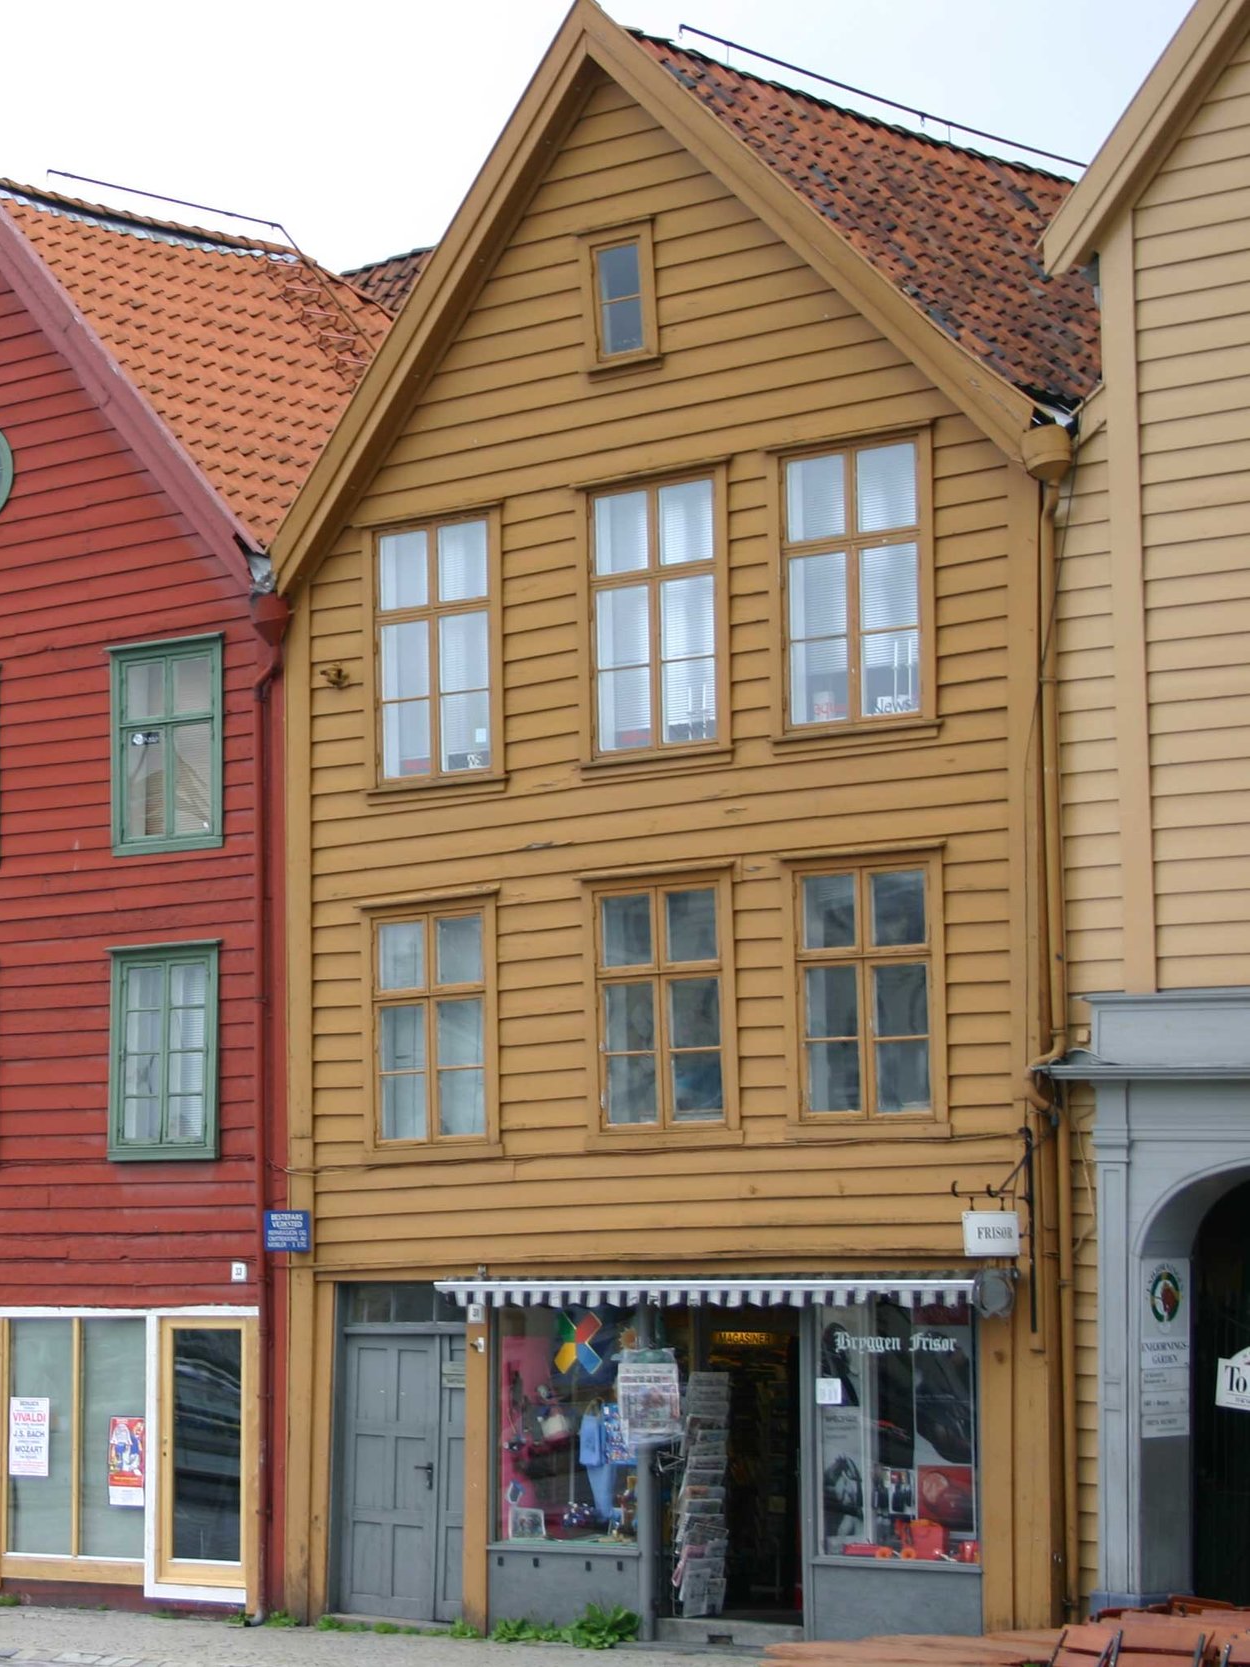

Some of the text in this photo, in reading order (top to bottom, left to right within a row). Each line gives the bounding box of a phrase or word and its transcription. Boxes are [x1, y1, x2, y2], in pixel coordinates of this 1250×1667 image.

[718, 1332, 771, 1345] MAGASINER
[834, 1331, 900, 1354] Bryggen
[1224, 1365, 1248, 1394] To
[13, 1412, 47, 1422] VIVALDI
[27, 1430, 46, 1438] BACH
